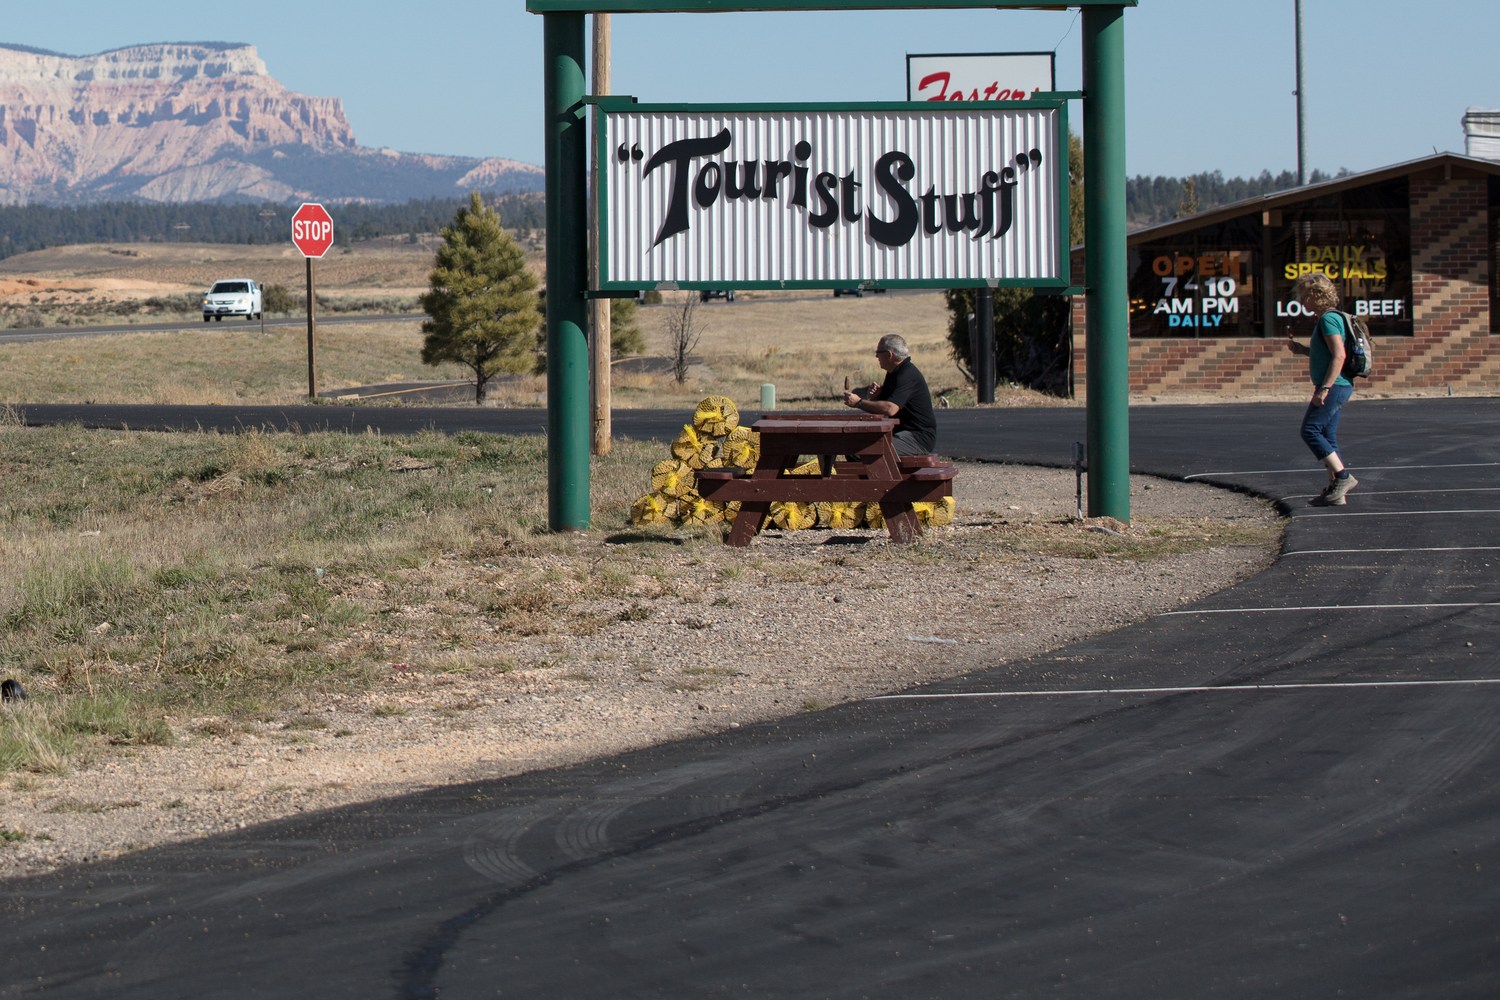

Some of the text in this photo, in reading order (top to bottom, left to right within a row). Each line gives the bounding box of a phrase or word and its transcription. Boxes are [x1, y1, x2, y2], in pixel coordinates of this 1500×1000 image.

[295, 220, 331, 241] STOP
[1306, 245, 1365, 262] DAILY
[1152, 256, 1240, 276] OPEN
[1161, 277, 1178, 296] 7
[1204, 276, 1236, 297] 10
[1153, 297, 1239, 314] AM PM
[1355, 300, 1405, 316] BEEF
[1168, 314, 1223, 327] DAILY
